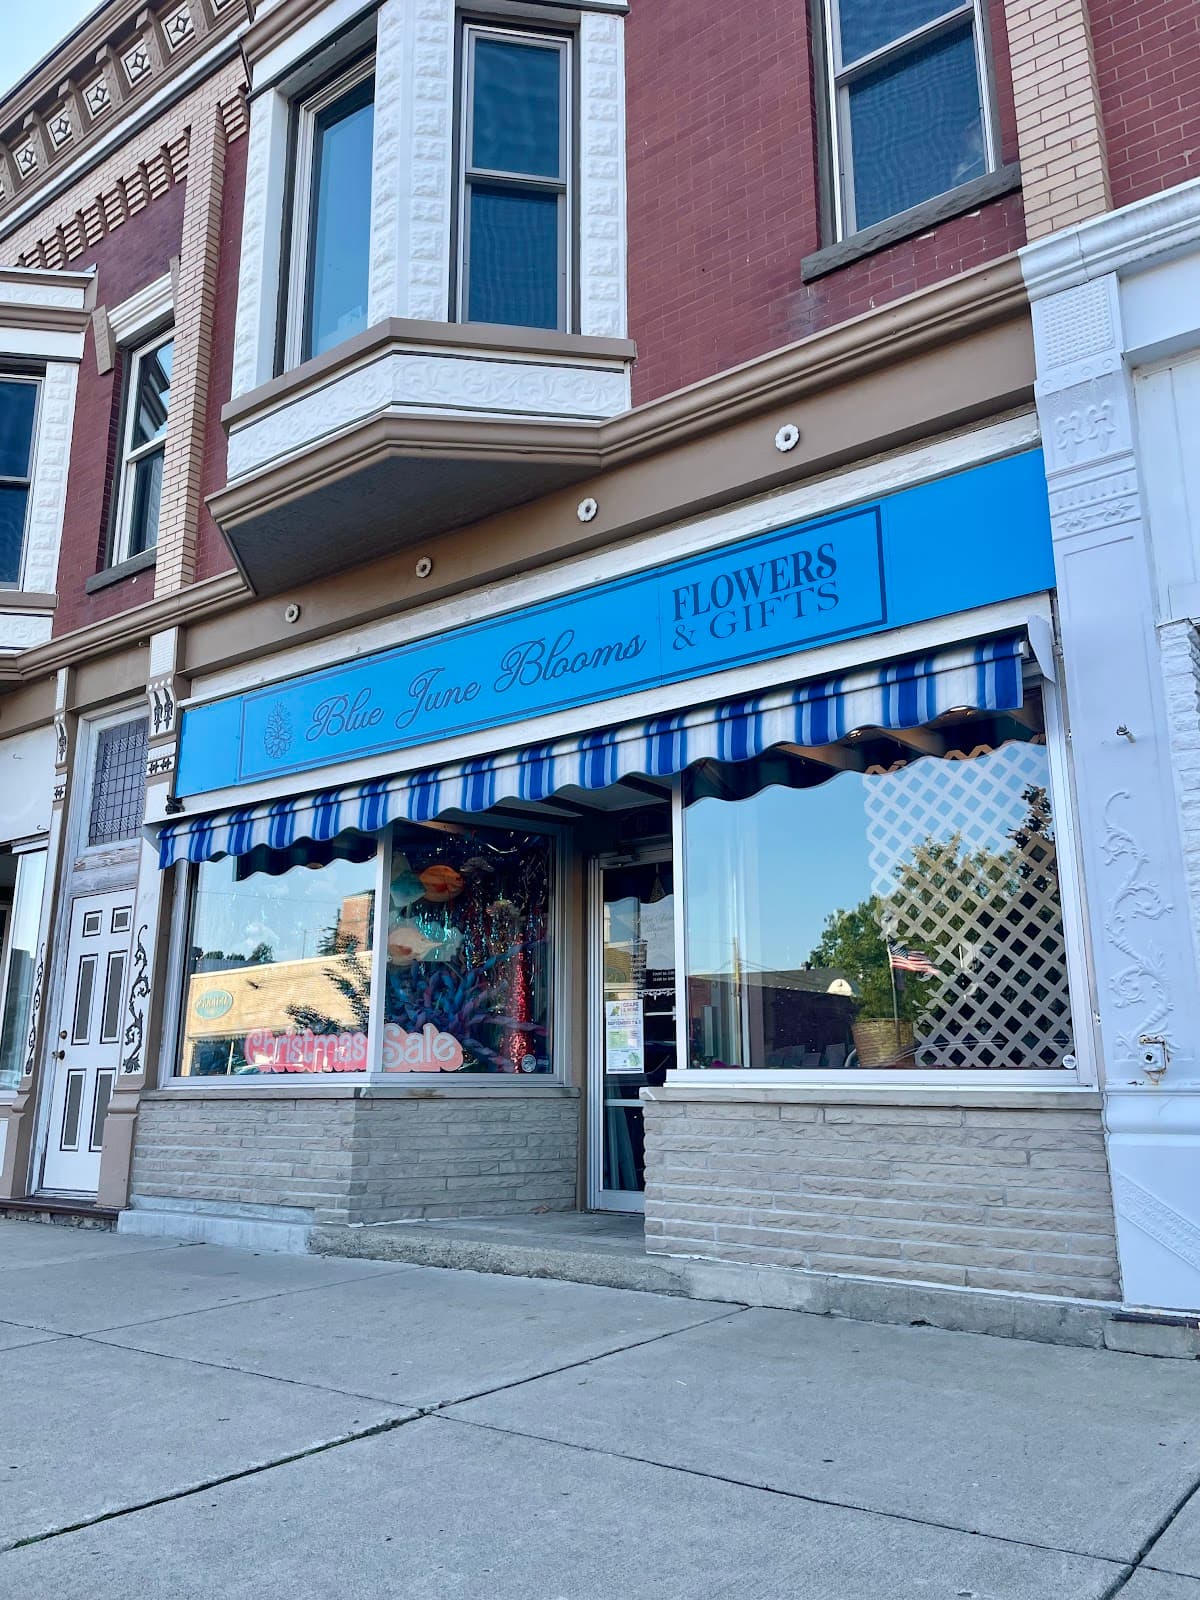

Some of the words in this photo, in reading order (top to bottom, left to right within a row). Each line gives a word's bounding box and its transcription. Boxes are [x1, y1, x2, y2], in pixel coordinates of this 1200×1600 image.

[672, 543, 838, 622] FLOWERS
[672, 624, 697, 651] &
[709, 580, 840, 639] GIFTS
[305, 686, 386, 742] Blue
[394, 666, 482, 730] June
[492, 628, 648, 693] Blooms
[249, 1026, 366, 1066] Christmas
[382, 1023, 457, 1068] Sale
